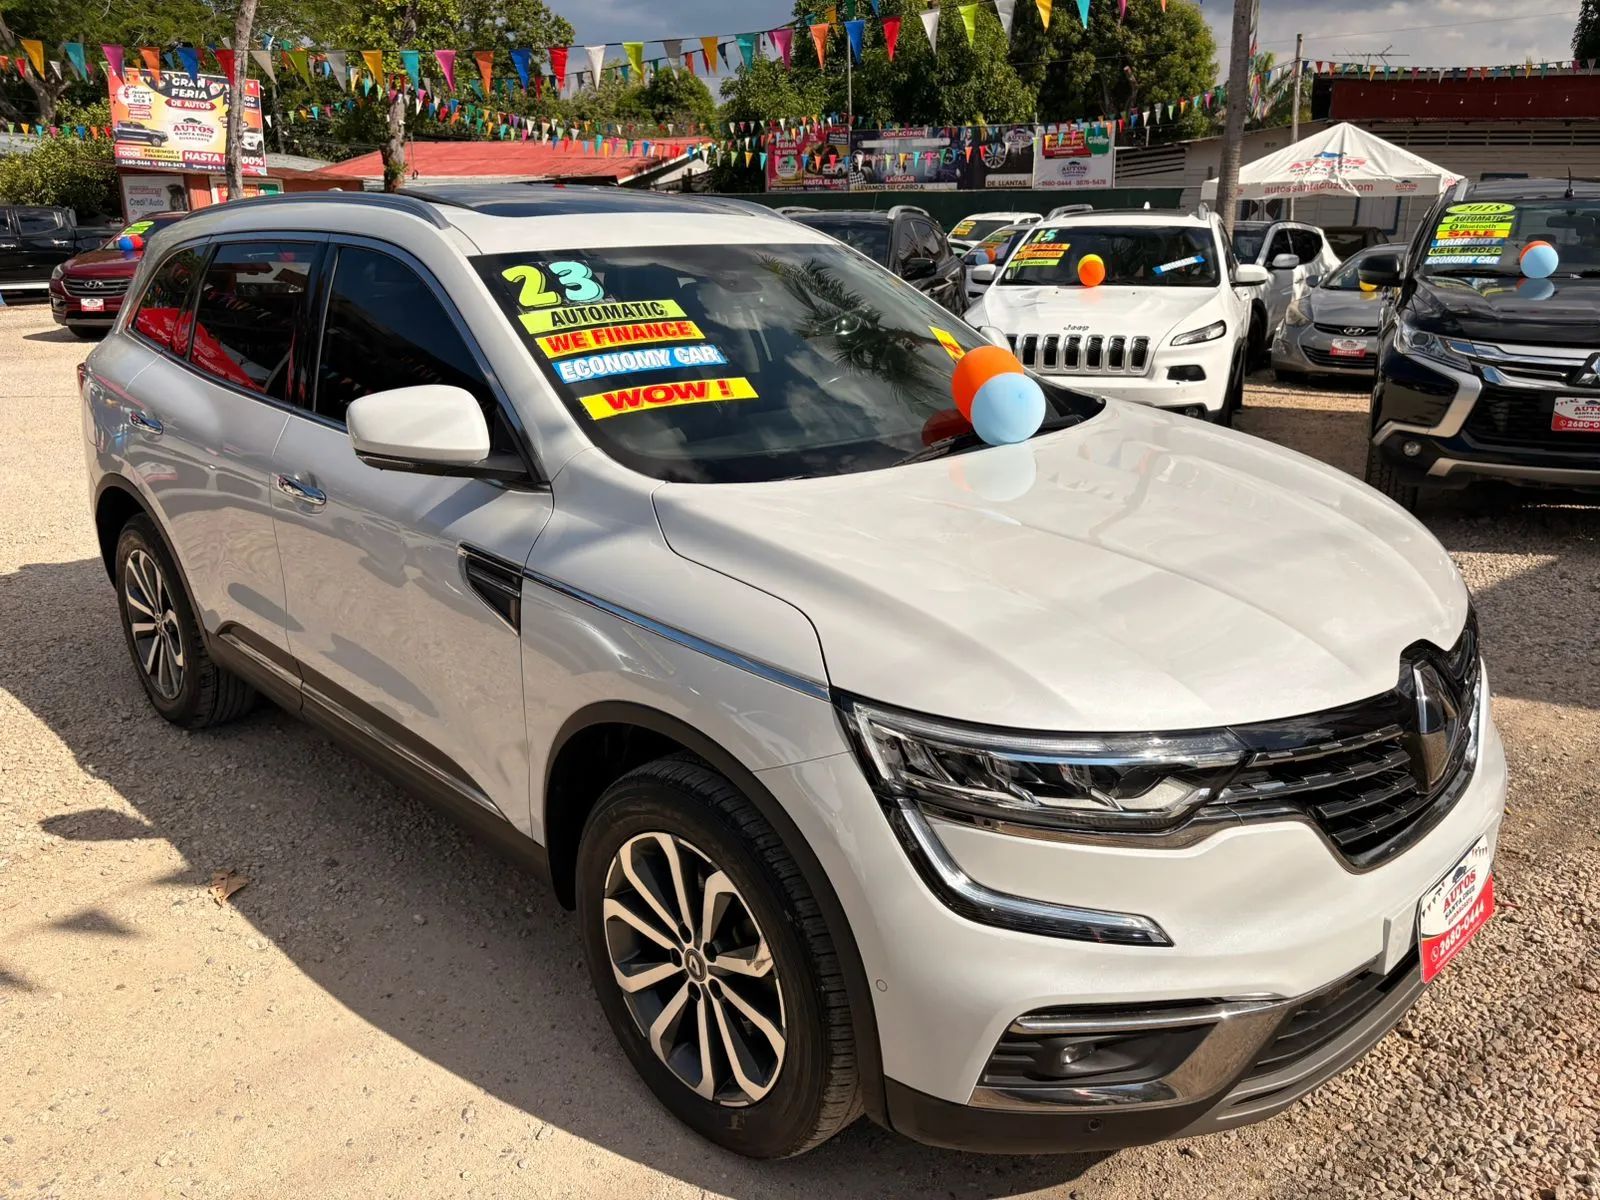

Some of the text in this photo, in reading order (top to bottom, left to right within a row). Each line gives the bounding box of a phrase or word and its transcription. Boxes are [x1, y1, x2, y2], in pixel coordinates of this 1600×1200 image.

[172, 77, 206, 88] GRAN
[171, 88, 207, 99] FERIA
[184, 100, 211, 109] AUTOS
[173, 124, 214, 134] AUTOS
[184, 151, 221, 162] HASTA
[1288, 159, 1367, 170] AUTOS
[1458, 204, 1505, 212] 2018
[1032, 229, 1059, 243] 15
[1425, 256, 1500, 264] ECONOMY CAR
[501, 261, 605, 307] 23
[550, 301, 668, 327] AUTOMATIC
[545, 322, 694, 353] WE FINANCE
[559, 344, 722, 381] ECONOMY CAR
[602, 381, 708, 411] WOW
[1443, 869, 1477, 913] AUTOS
[1445, 898, 1463, 919] SANTA
[1440, 900, 1485, 954] 2680-0444
